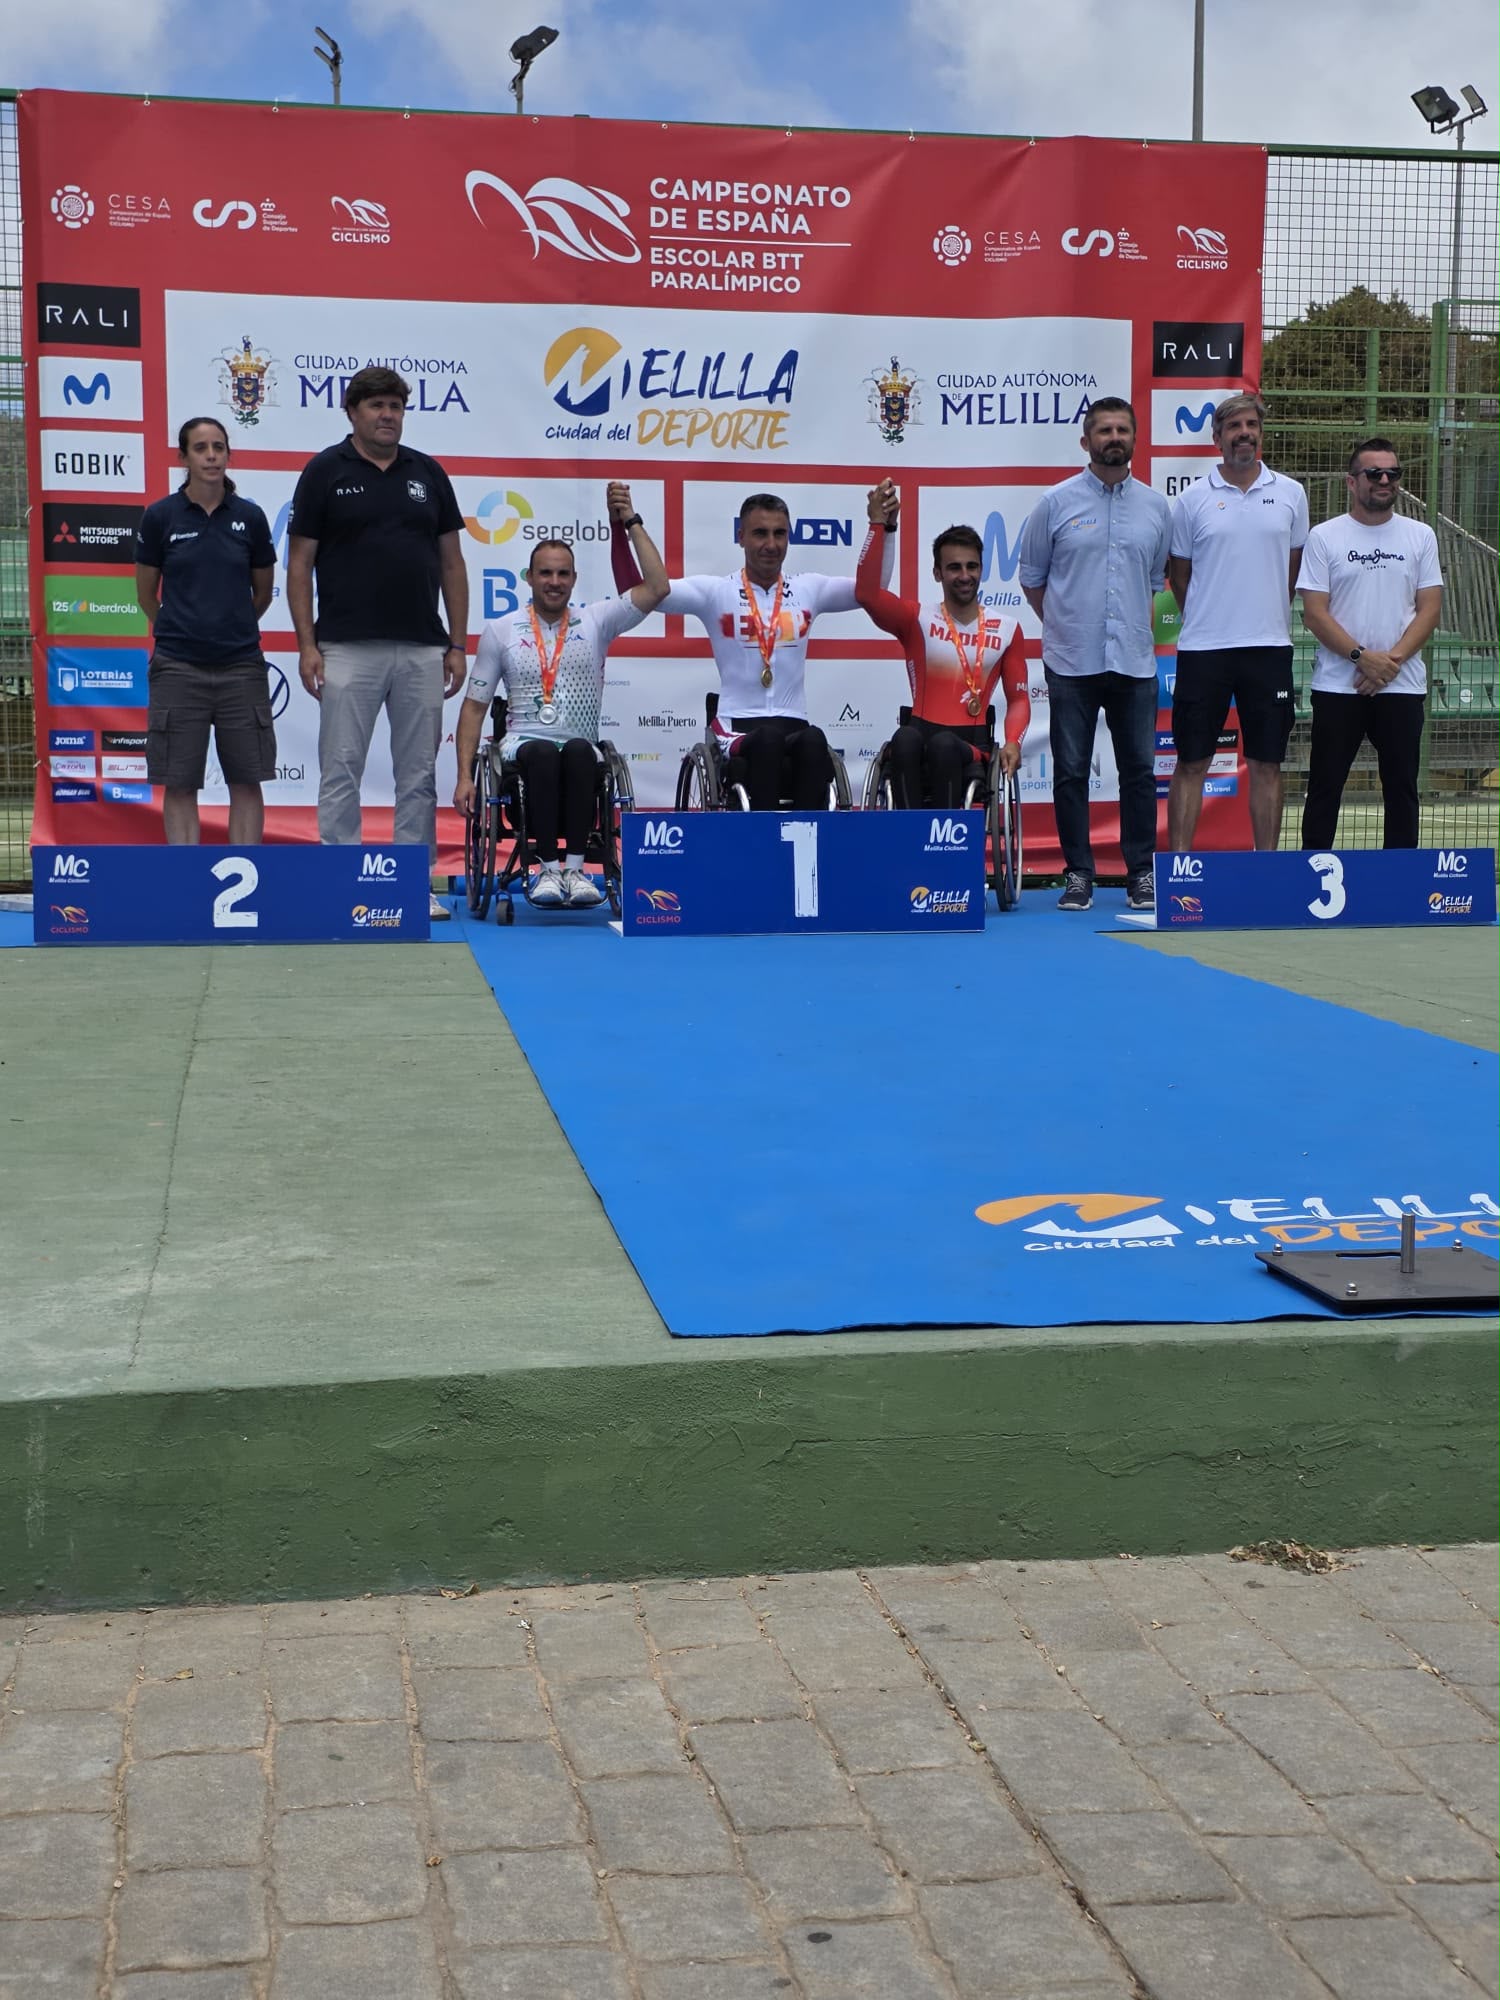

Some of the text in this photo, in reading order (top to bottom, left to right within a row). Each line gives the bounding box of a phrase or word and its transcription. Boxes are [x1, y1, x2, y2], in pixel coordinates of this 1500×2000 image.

[649, 177, 851, 209] CAMPEONATO
[108, 194, 171, 211] CESA
[649, 206, 811, 235] DE ESPAÑA
[331, 232, 391, 244] CICLISMO
[984, 230, 1041, 245] CESA
[650, 247, 804, 271] ESCOLAR BTT
[1176, 259, 1228, 270] CICLISMO
[650, 269, 801, 294] PARALÍMPICO
[45, 304, 128, 328] RALI
[1163, 342, 1233, 361] RALI
[294, 354, 468, 374] CIUDAD AUTÓNOMA
[311, 374, 322, 383] DE
[937, 370, 1098, 388] CIUDAD AUTÓNOMA
[951, 393, 962, 401] DE
[545, 408, 791, 450] ciudad del DEPORTE
[55, 452, 125, 476] GOBIK
[80, 527, 132, 536] MITSUBISHI
[80, 536, 119, 544] MOTORS
[522, 519, 611, 547] serglob
[52, 601, 138, 614] 125 Iberdrola
[1162, 615, 1175, 624] 125
[80, 670, 133, 680] LOTERÍAS
[638, 715, 697, 728] Melilla Puerto
[1217, 735, 1236, 743] sport
[780, 820, 818, 918] 1
[210, 856, 259, 928] 2
[1307, 852, 1346, 920] 3
[932, 903, 968, 913] DEPORTE
[636, 915, 681, 924] CICLISMO
[1023, 1219, 1500, 1252] ciudad del DEPO
